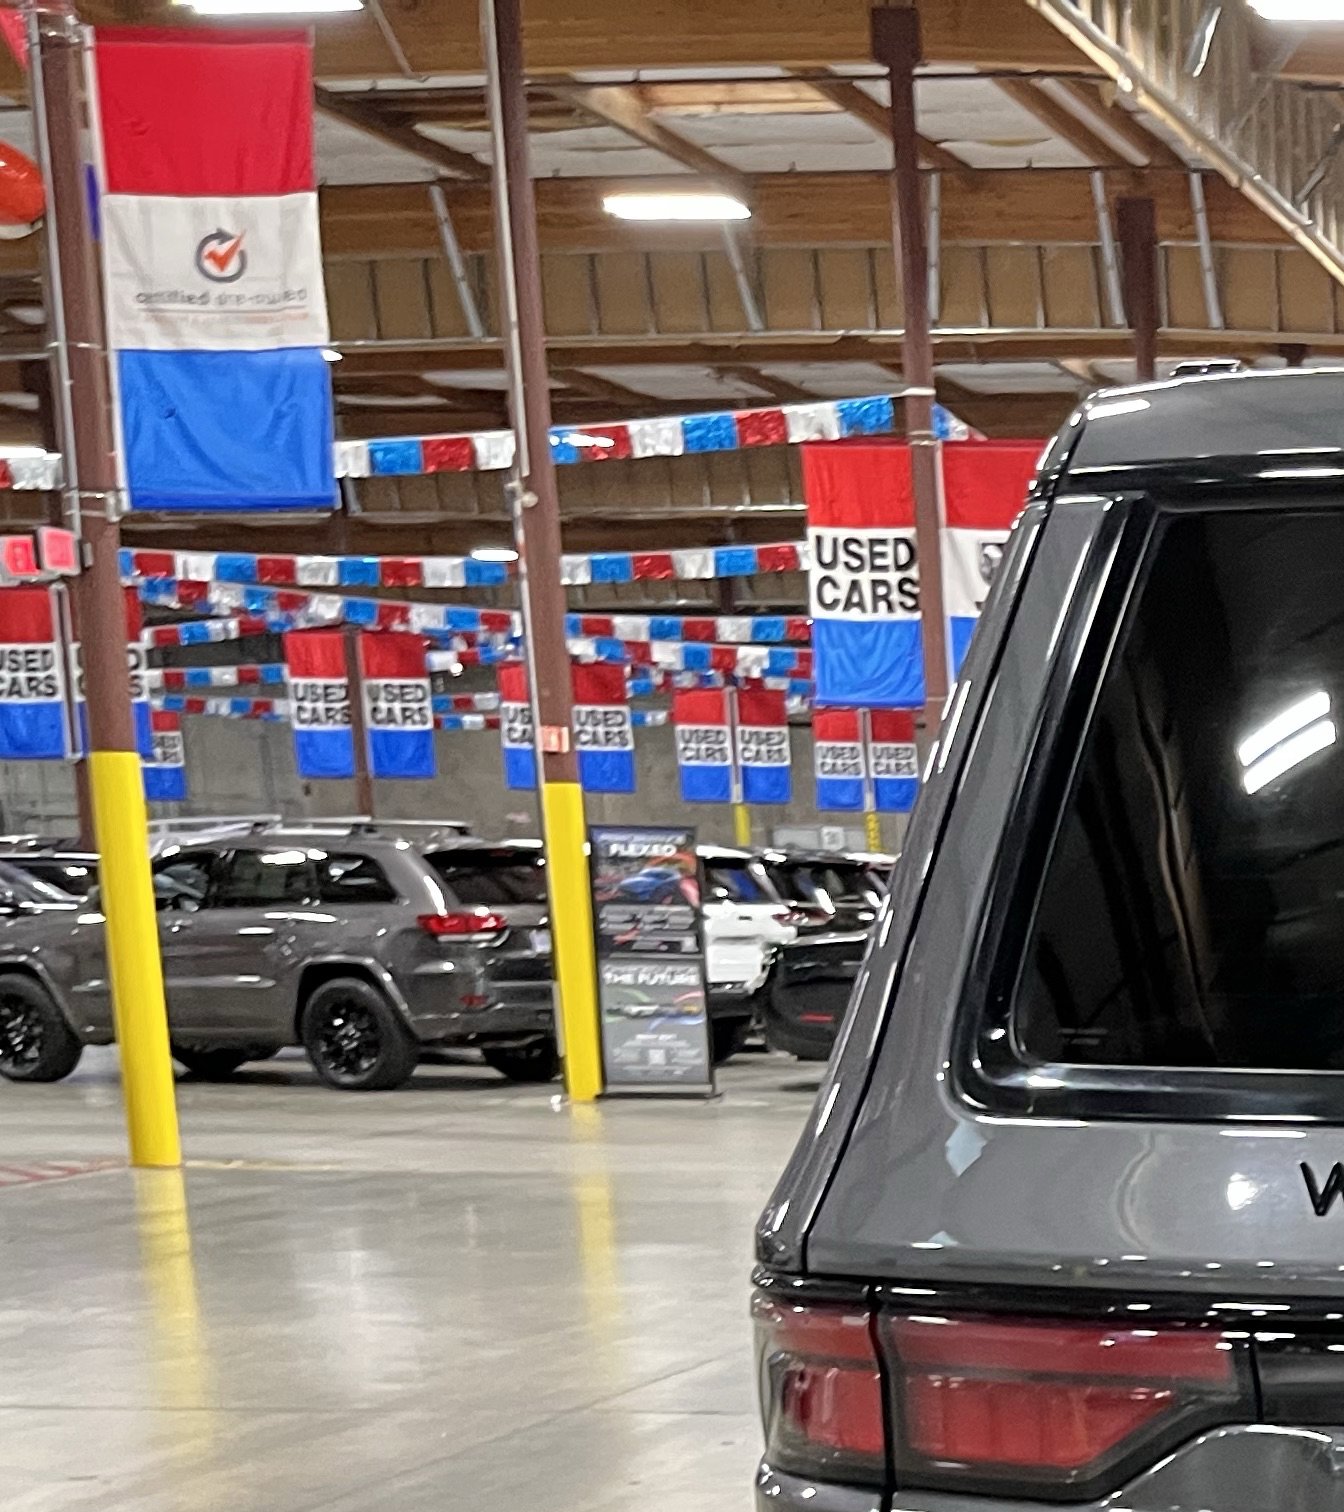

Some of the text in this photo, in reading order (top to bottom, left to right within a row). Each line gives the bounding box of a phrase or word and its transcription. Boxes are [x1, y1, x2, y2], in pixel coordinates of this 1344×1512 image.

[815, 535, 916, 573] USED
[816, 575, 919, 614] CARS
[294, 683, 349, 703] USED
[366, 684, 427, 703] USED
[296, 705, 351, 724] CARS
[371, 706, 429, 725] CARS
[502, 706, 533, 724] US
[575, 710, 627, 727] USED
[575, 730, 629, 746] CARS
[680, 729, 727, 745] USED
[741, 729, 787, 746] USED
[682, 747, 728, 762] CARS
[743, 747, 788, 763] CARS
[818, 746, 860, 760] USED
[872, 746, 914, 760] USED
